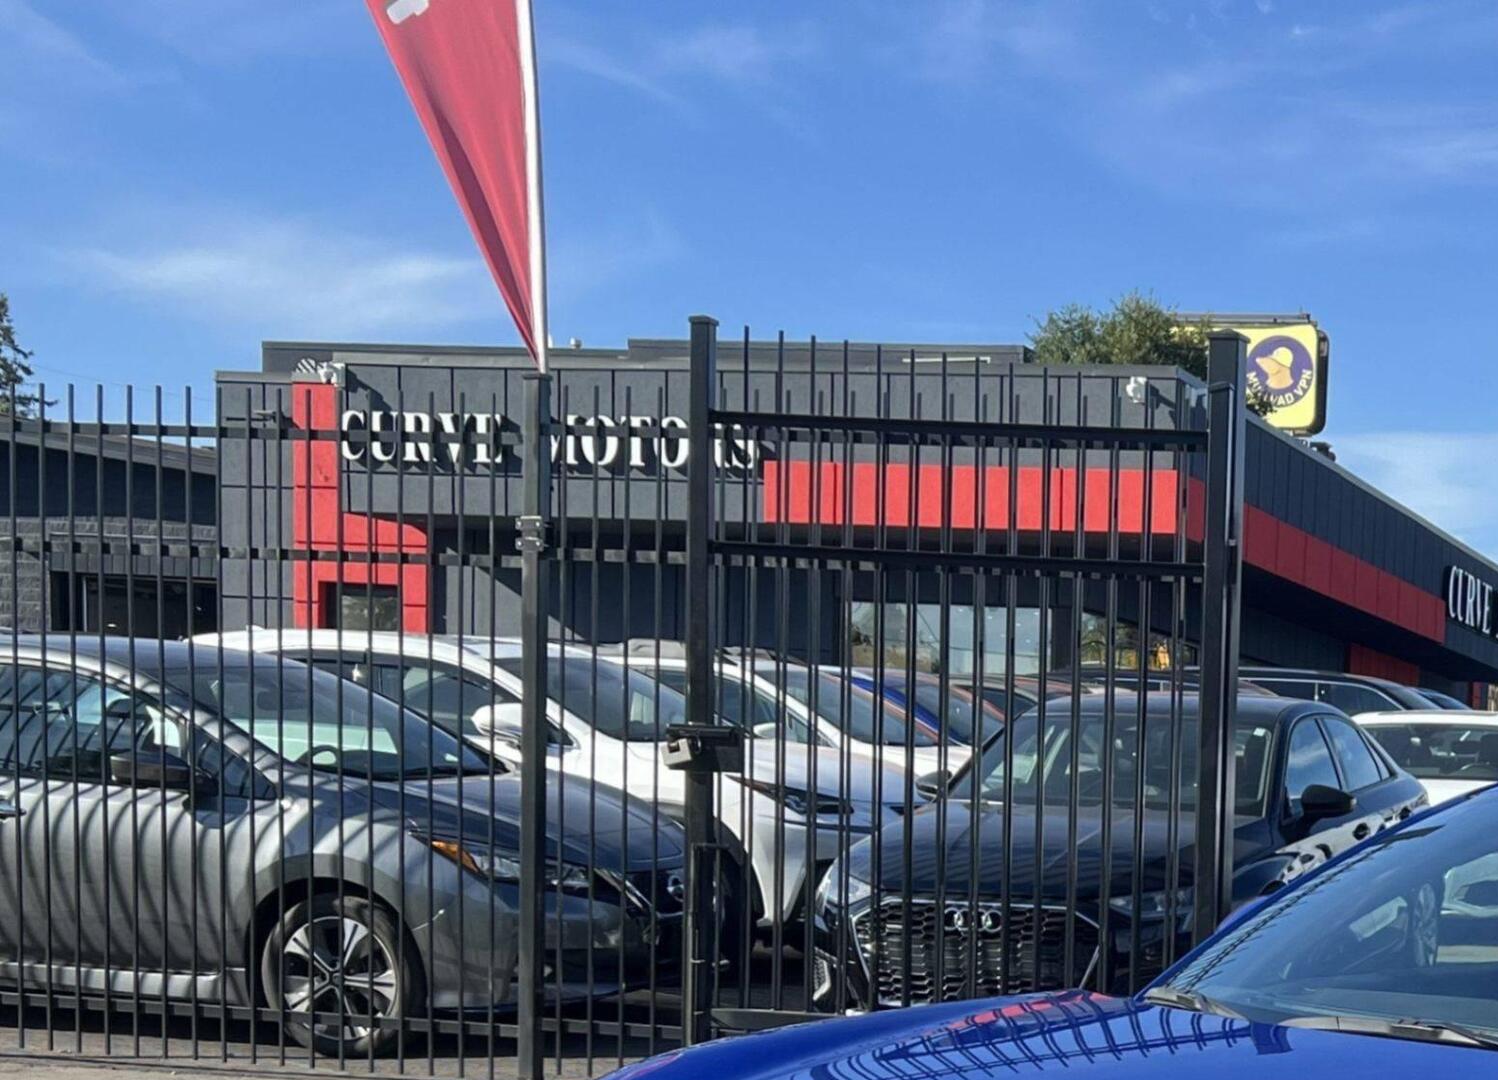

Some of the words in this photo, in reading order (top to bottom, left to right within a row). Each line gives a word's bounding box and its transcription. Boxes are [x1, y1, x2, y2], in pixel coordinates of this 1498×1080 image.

[1246, 371, 1295, 407] MULVAD
[1293, 368, 1313, 397] VPN
[341, 410, 504, 464] CURVE
[1447, 565, 1494, 636] CURVE
